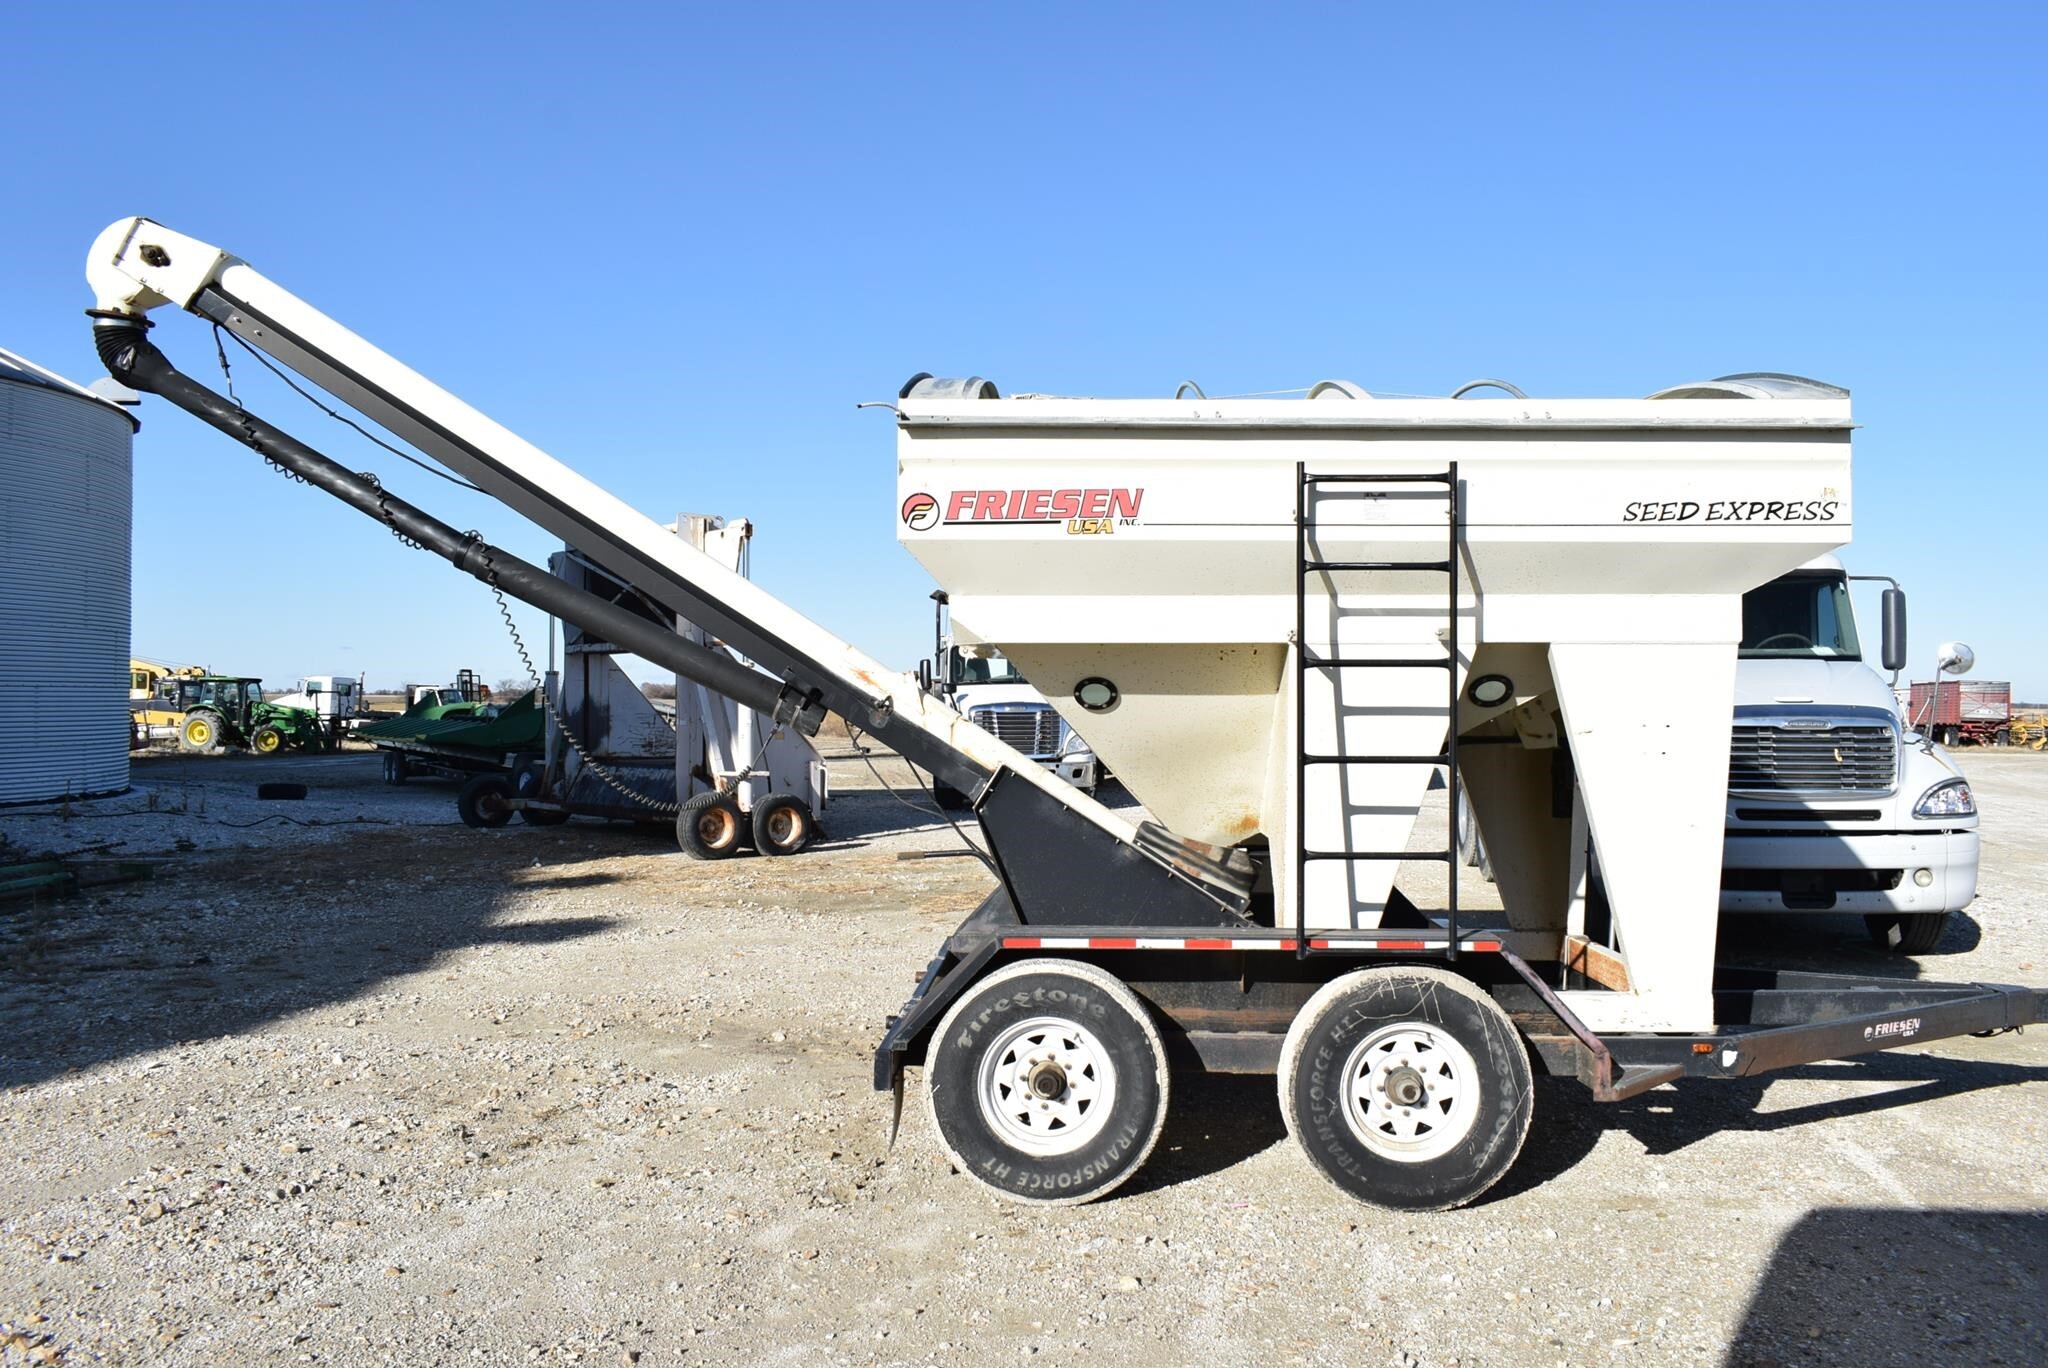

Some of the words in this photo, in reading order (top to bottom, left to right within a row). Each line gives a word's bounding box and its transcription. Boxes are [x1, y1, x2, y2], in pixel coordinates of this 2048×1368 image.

[945, 488, 1144, 520] FRIESEN
[1623, 501, 1700, 522] SEED
[1705, 501, 1839, 521] EXPRESS
[1067, 518, 1114, 535] USA
[957, 987, 1105, 1048] Firestone
[1874, 1018, 1921, 1036] FRIESEN
[1310, 1046, 1361, 1177] TRANSFORCE
[982, 1157, 1011, 1180] HT
[1017, 1121, 1138, 1190] TRANSFORCE
